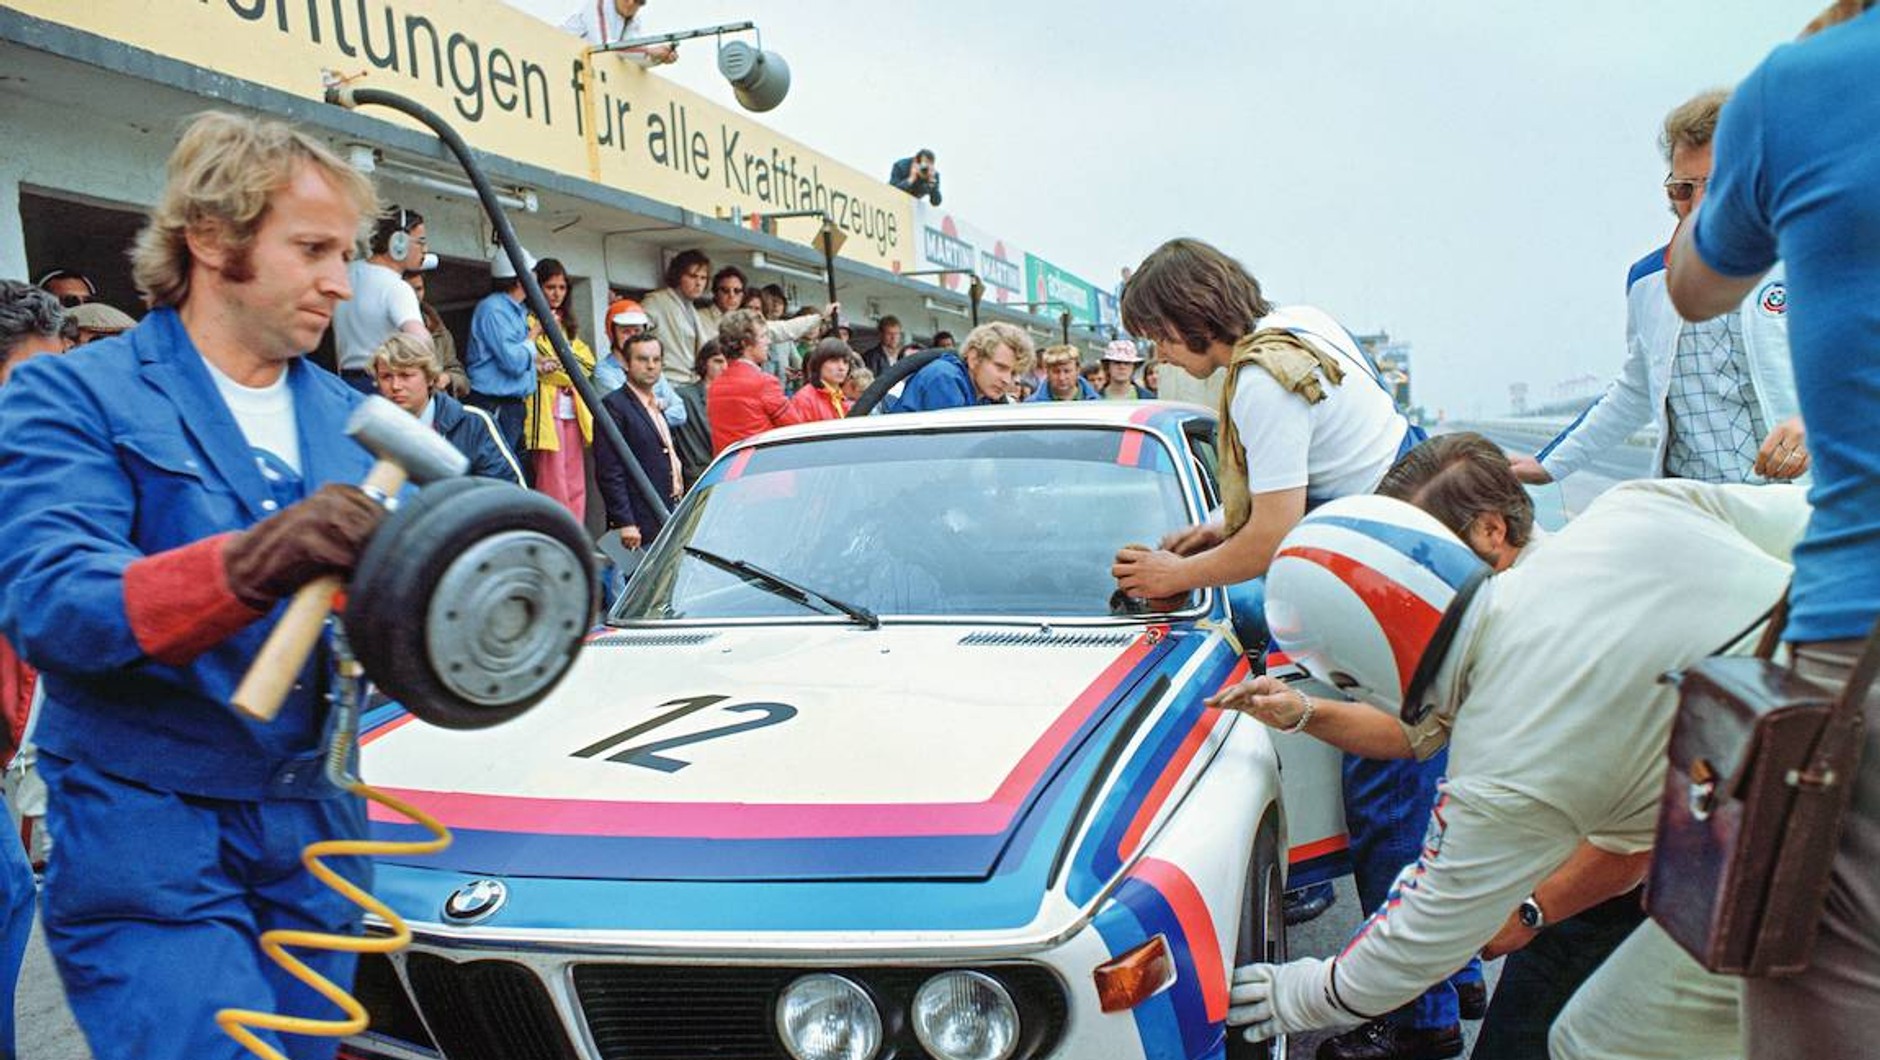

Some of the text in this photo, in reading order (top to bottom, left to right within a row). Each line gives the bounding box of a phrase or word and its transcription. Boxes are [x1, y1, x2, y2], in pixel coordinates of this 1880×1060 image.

[646, 101, 710, 180] alle
[722, 124, 898, 257] Kraftfahrzeuge
[568, 694, 799, 774] 12
